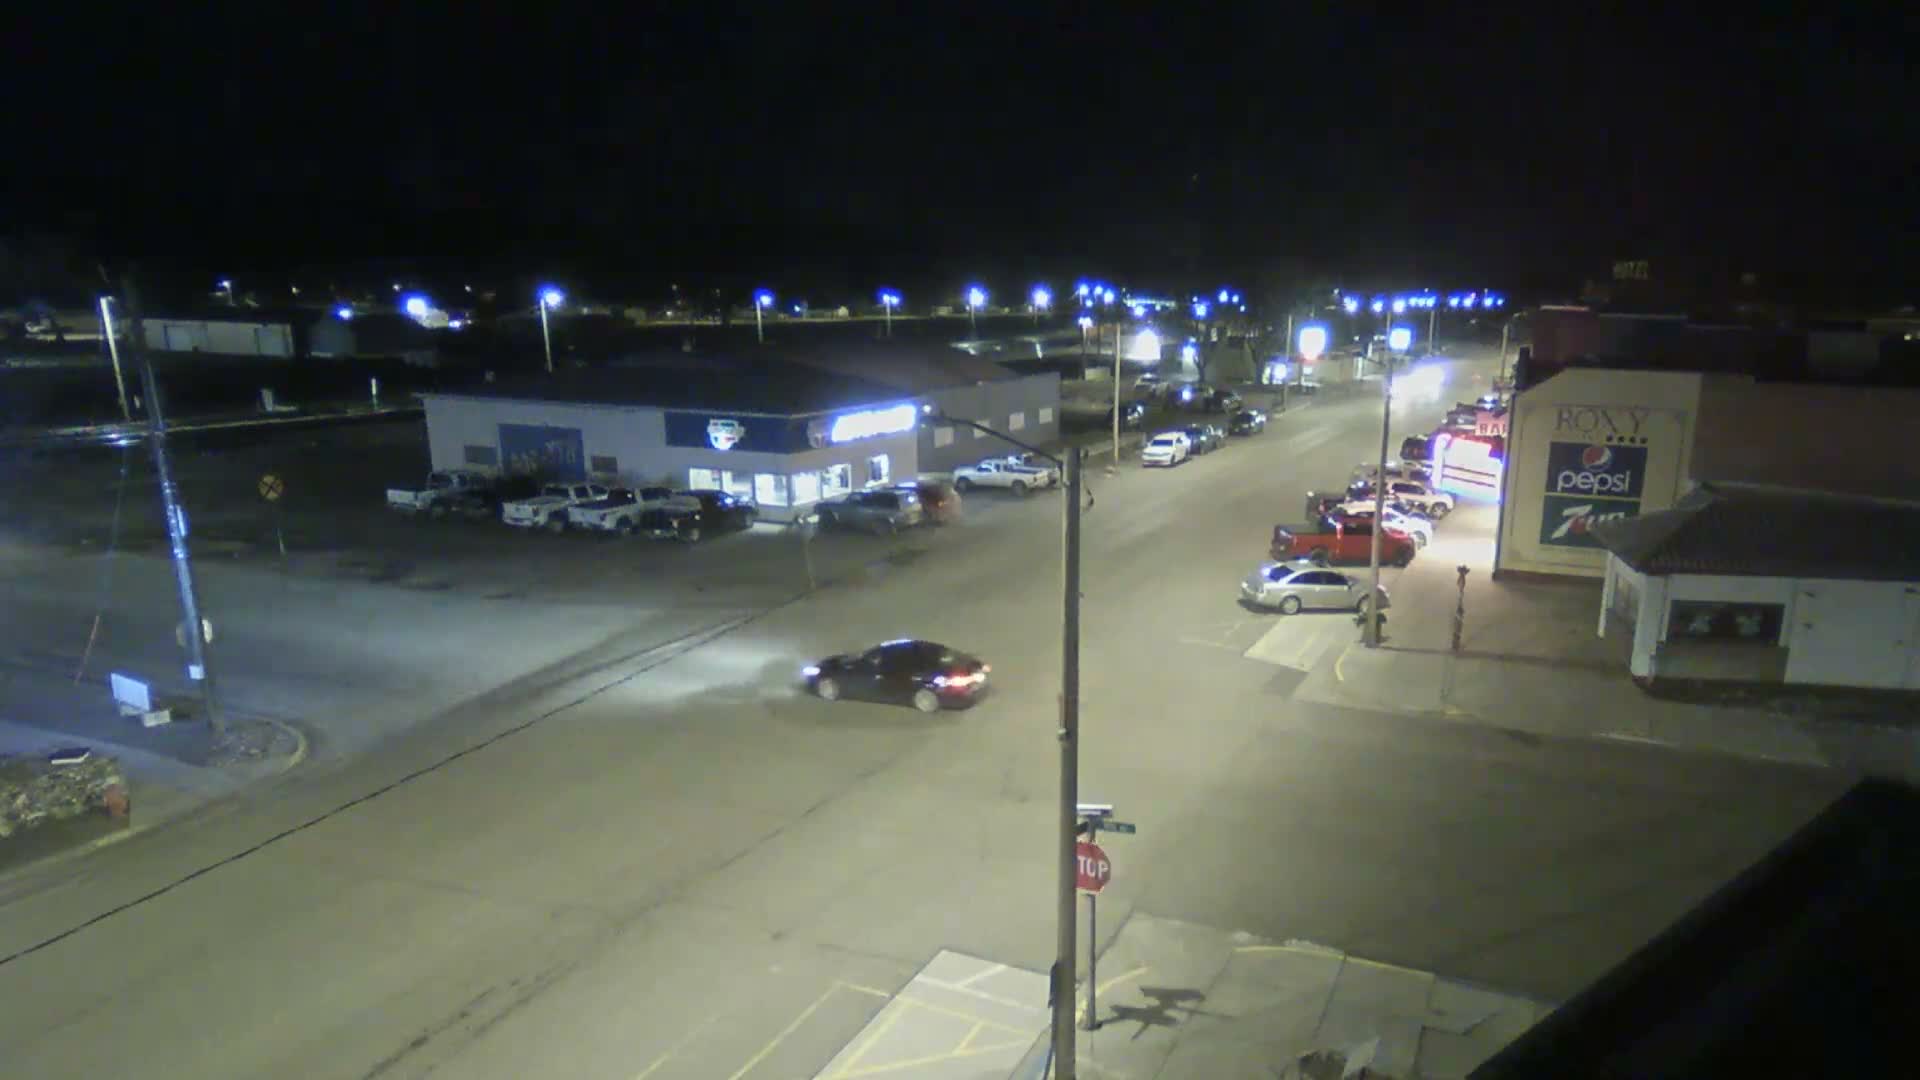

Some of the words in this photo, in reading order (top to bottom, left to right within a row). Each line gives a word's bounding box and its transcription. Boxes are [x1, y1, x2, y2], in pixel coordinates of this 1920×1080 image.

[1556, 406, 1650, 434] ROXY
[1557, 469, 1630, 496] pepsi
[1077, 855, 1109, 879] TOP
